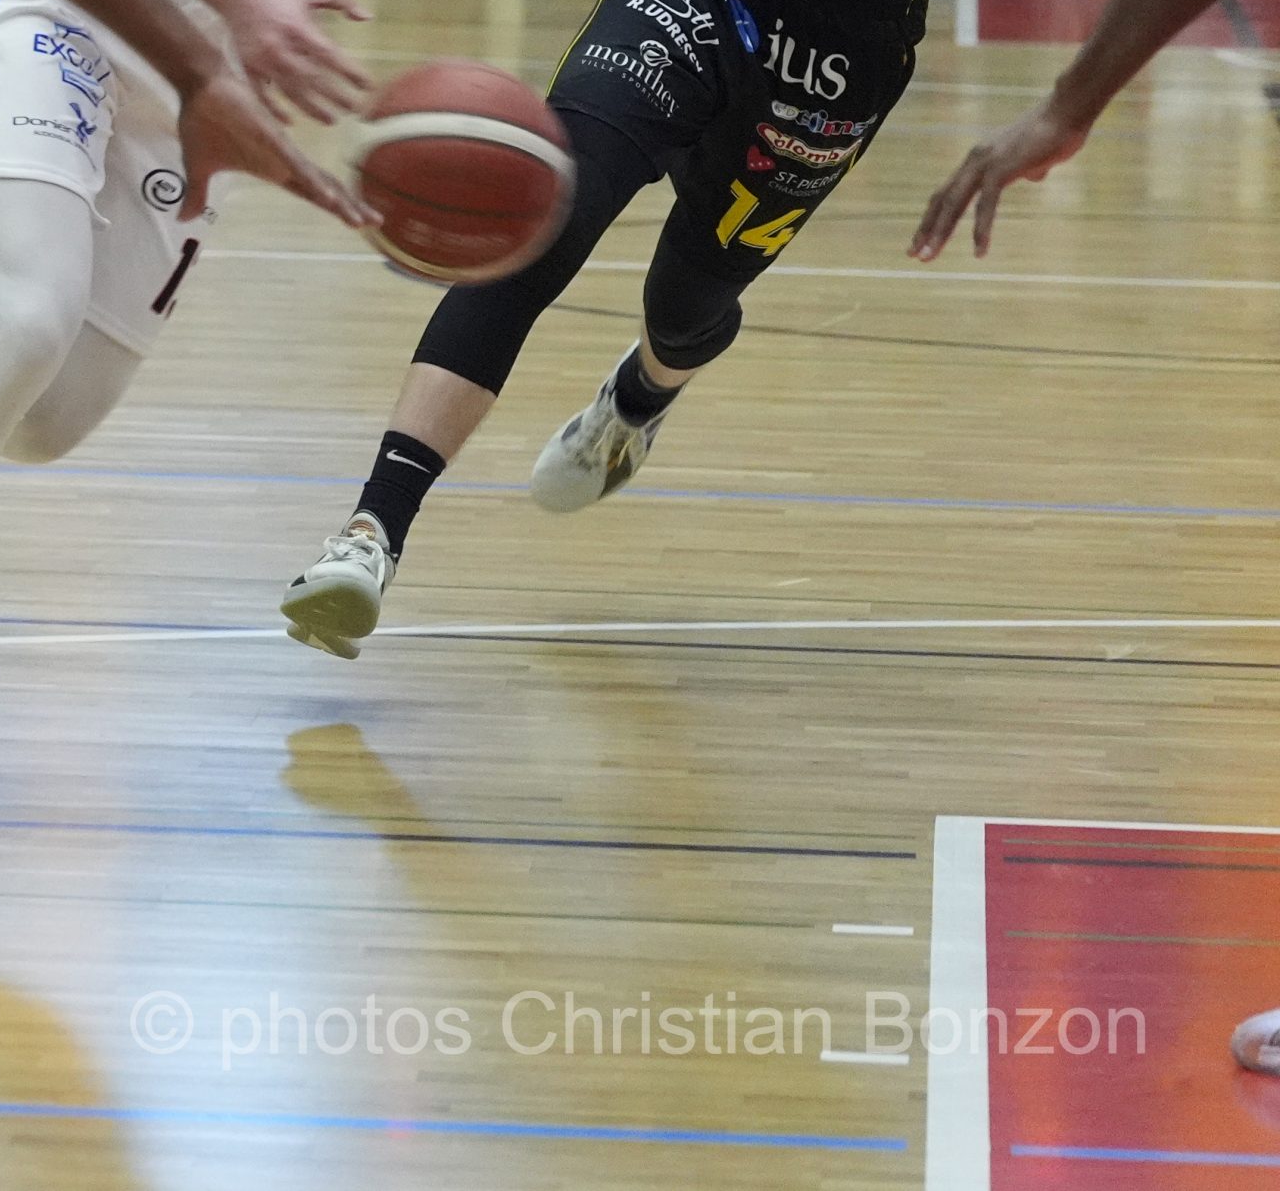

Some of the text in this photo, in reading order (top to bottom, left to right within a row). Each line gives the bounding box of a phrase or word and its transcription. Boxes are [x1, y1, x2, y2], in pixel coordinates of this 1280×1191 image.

[581, 58, 615, 73] VILLE
[584, 44, 680, 118] monthey
[762, 18, 851, 101] ius
[756, 122, 842, 164] Colomb
[716, 178, 807, 257] 14
[151, 237, 200, 315] 1
